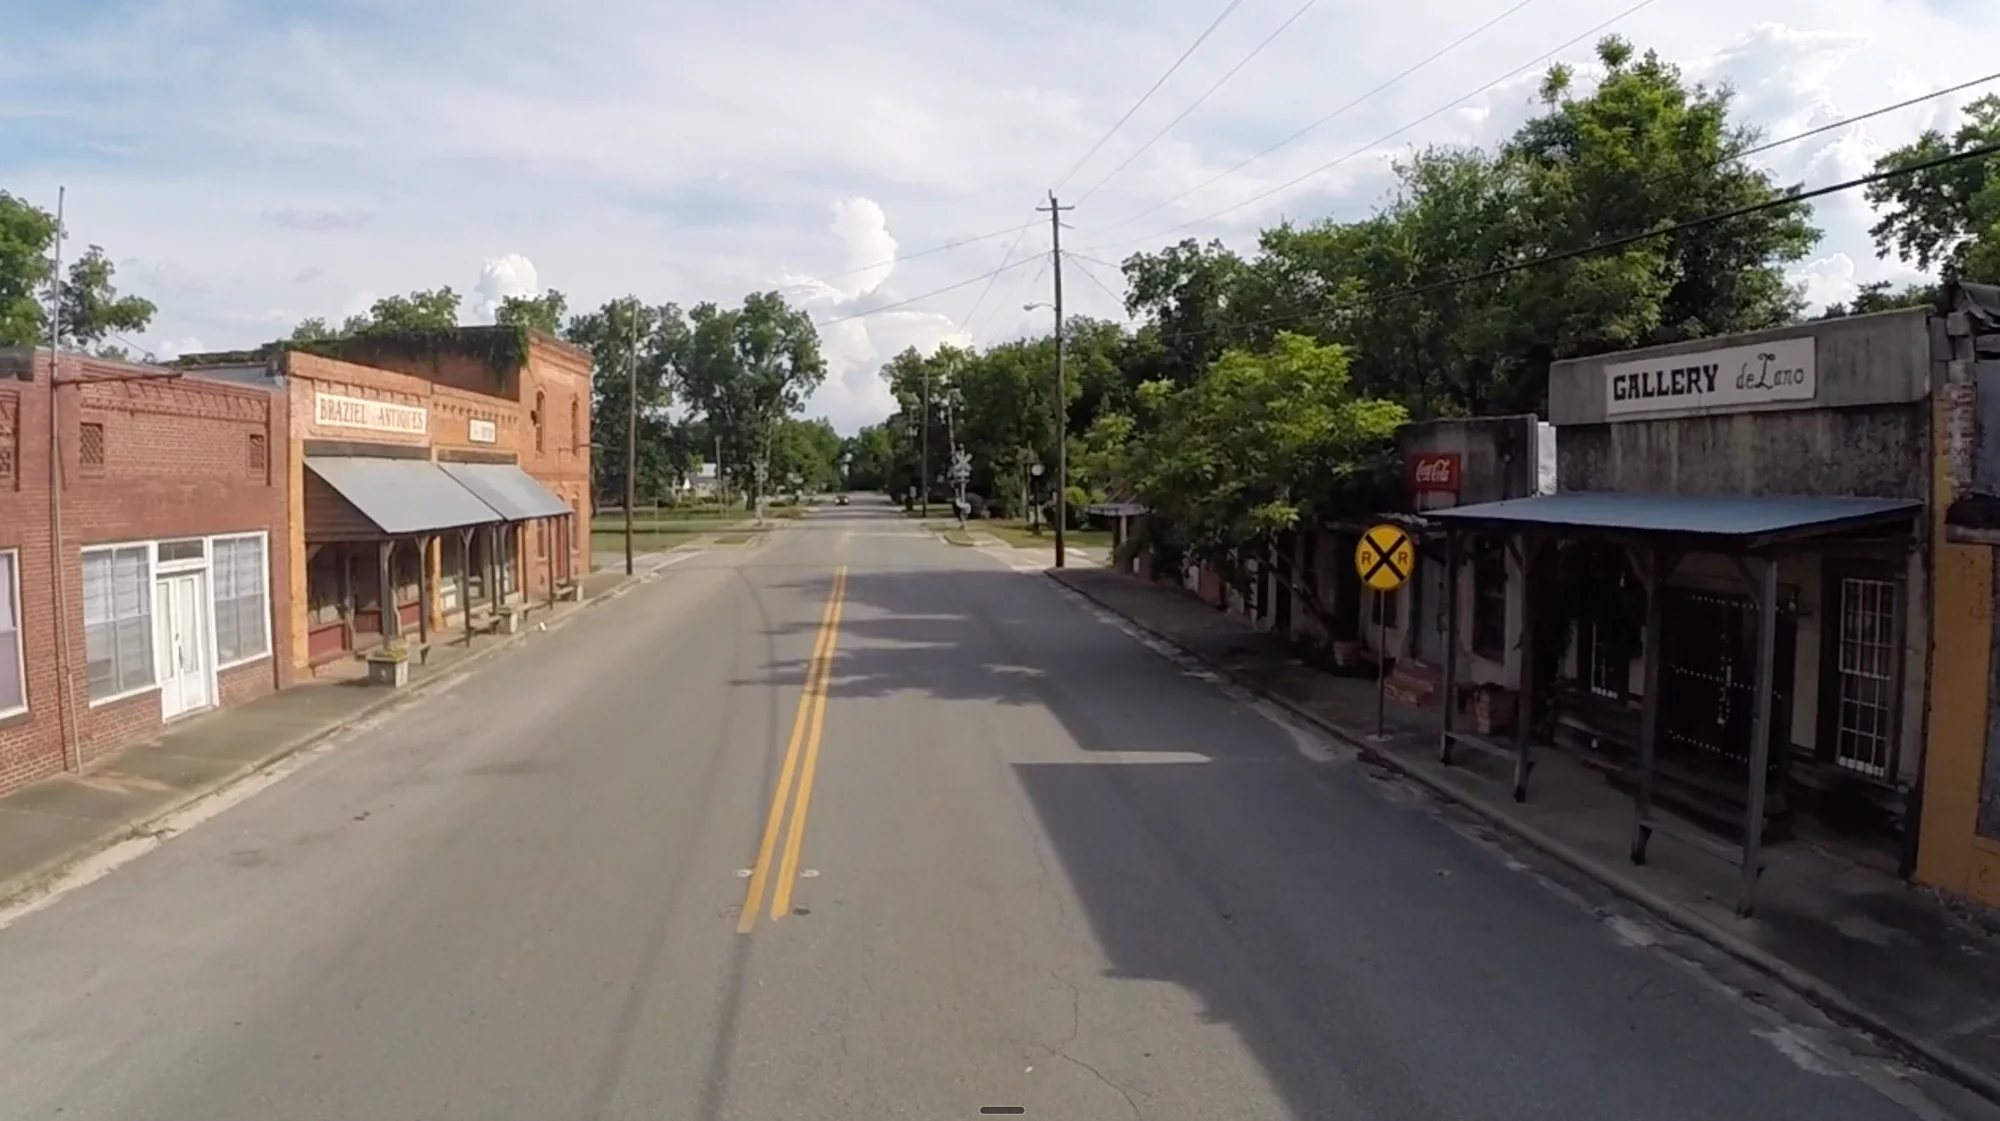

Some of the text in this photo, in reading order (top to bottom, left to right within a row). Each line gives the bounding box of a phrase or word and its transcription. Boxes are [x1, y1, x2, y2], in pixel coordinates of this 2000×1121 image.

[1613, 364, 1718, 400] GALLERY
[319, 398, 424, 429] BRAZIEL ANTIQUES
[1361, 551, 1408, 565] R R
